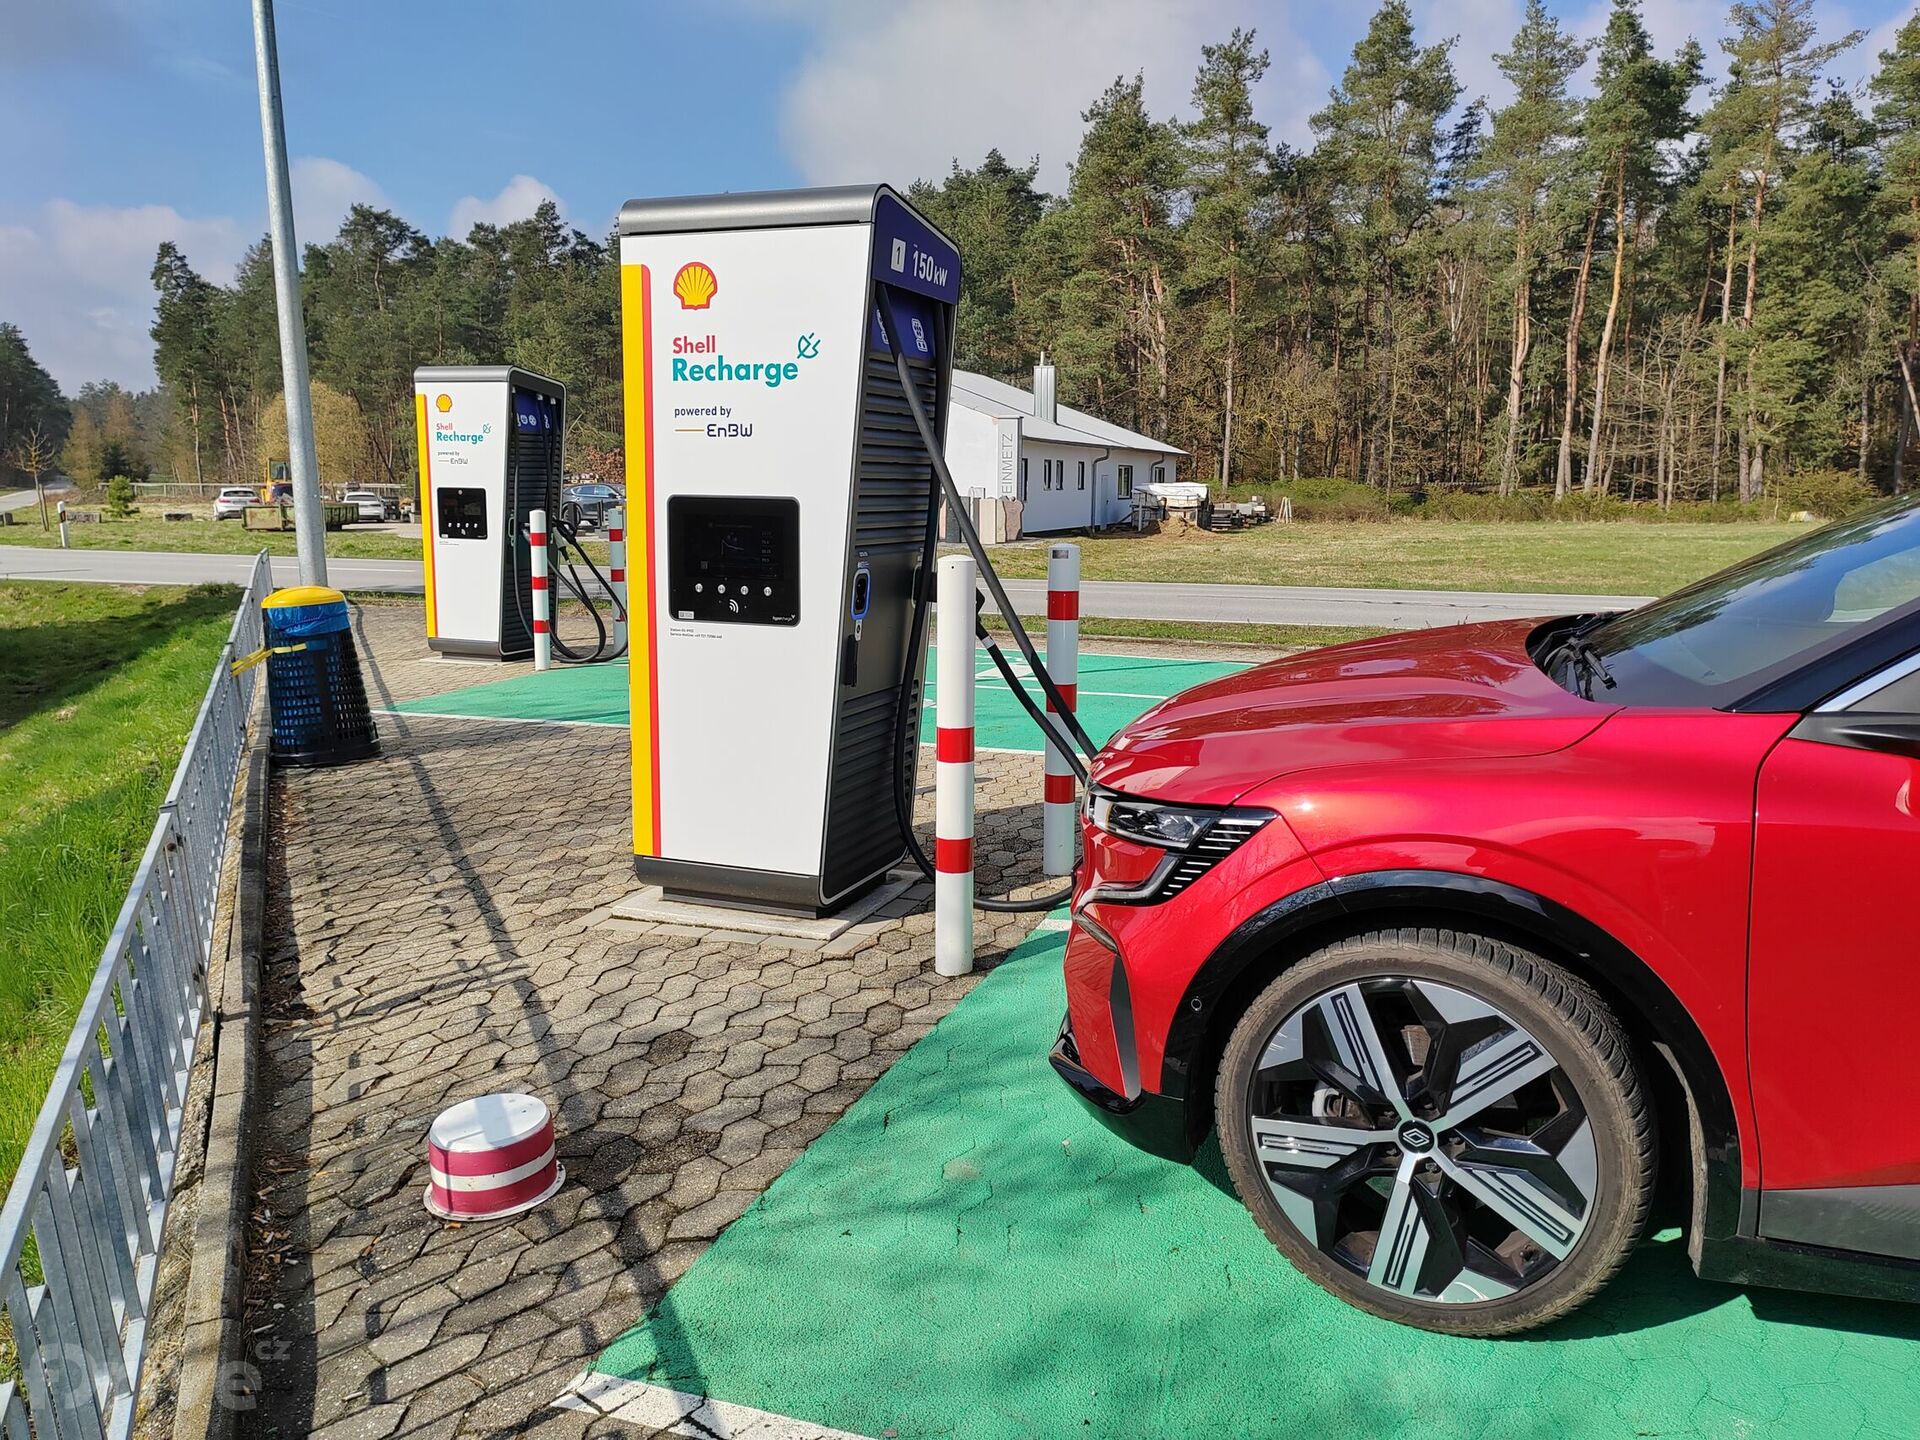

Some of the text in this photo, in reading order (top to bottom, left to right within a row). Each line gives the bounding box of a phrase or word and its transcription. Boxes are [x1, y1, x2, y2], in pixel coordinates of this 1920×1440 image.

[896, 246, 901, 265] 1
[672, 335, 716, 354] Shell
[672, 355, 798, 388] Recharge
[674, 406, 732, 418] powered by
[436, 422, 453, 431] Shell
[706, 423, 753, 438] EnBW
[436, 431, 484, 445] Recharge
